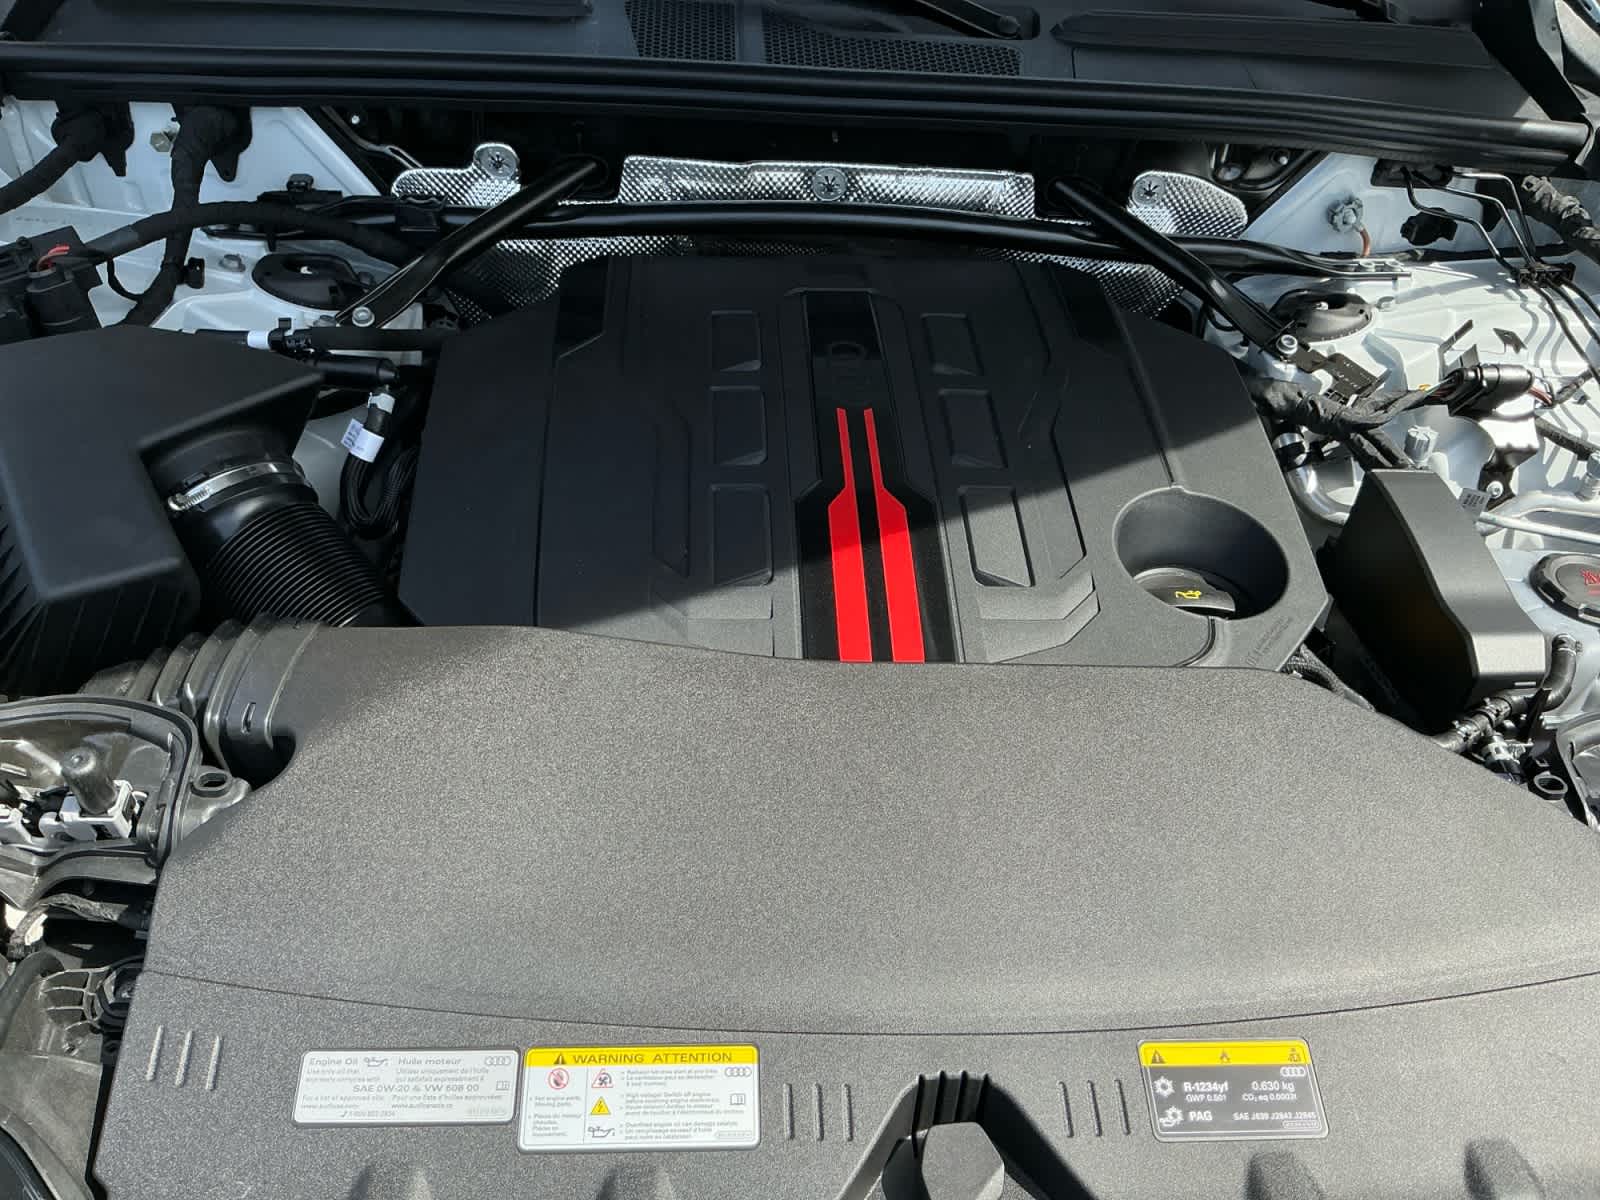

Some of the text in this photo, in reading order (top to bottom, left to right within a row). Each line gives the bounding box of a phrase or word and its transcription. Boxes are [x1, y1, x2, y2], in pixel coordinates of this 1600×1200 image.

[309, 1057, 358, 1067] Engine Oil
[398, 1057, 461, 1065] Huile moteur
[573, 1052, 733, 1064] WARNING ATTENTION
[352, 1084, 374, 1092] SAE
[376, 1084, 410, 1092] 0W-20
[424, 1083, 443, 1092] VW
[466, 1083, 480, 1092] 00
[1183, 1080, 1296, 1093] R-1234yf 0.630 kg
[1186, 1094, 1206, 1102] GWP
[1189, 1111, 1213, 1121] PAG
[1232, 1112, 1249, 1121] SAE
